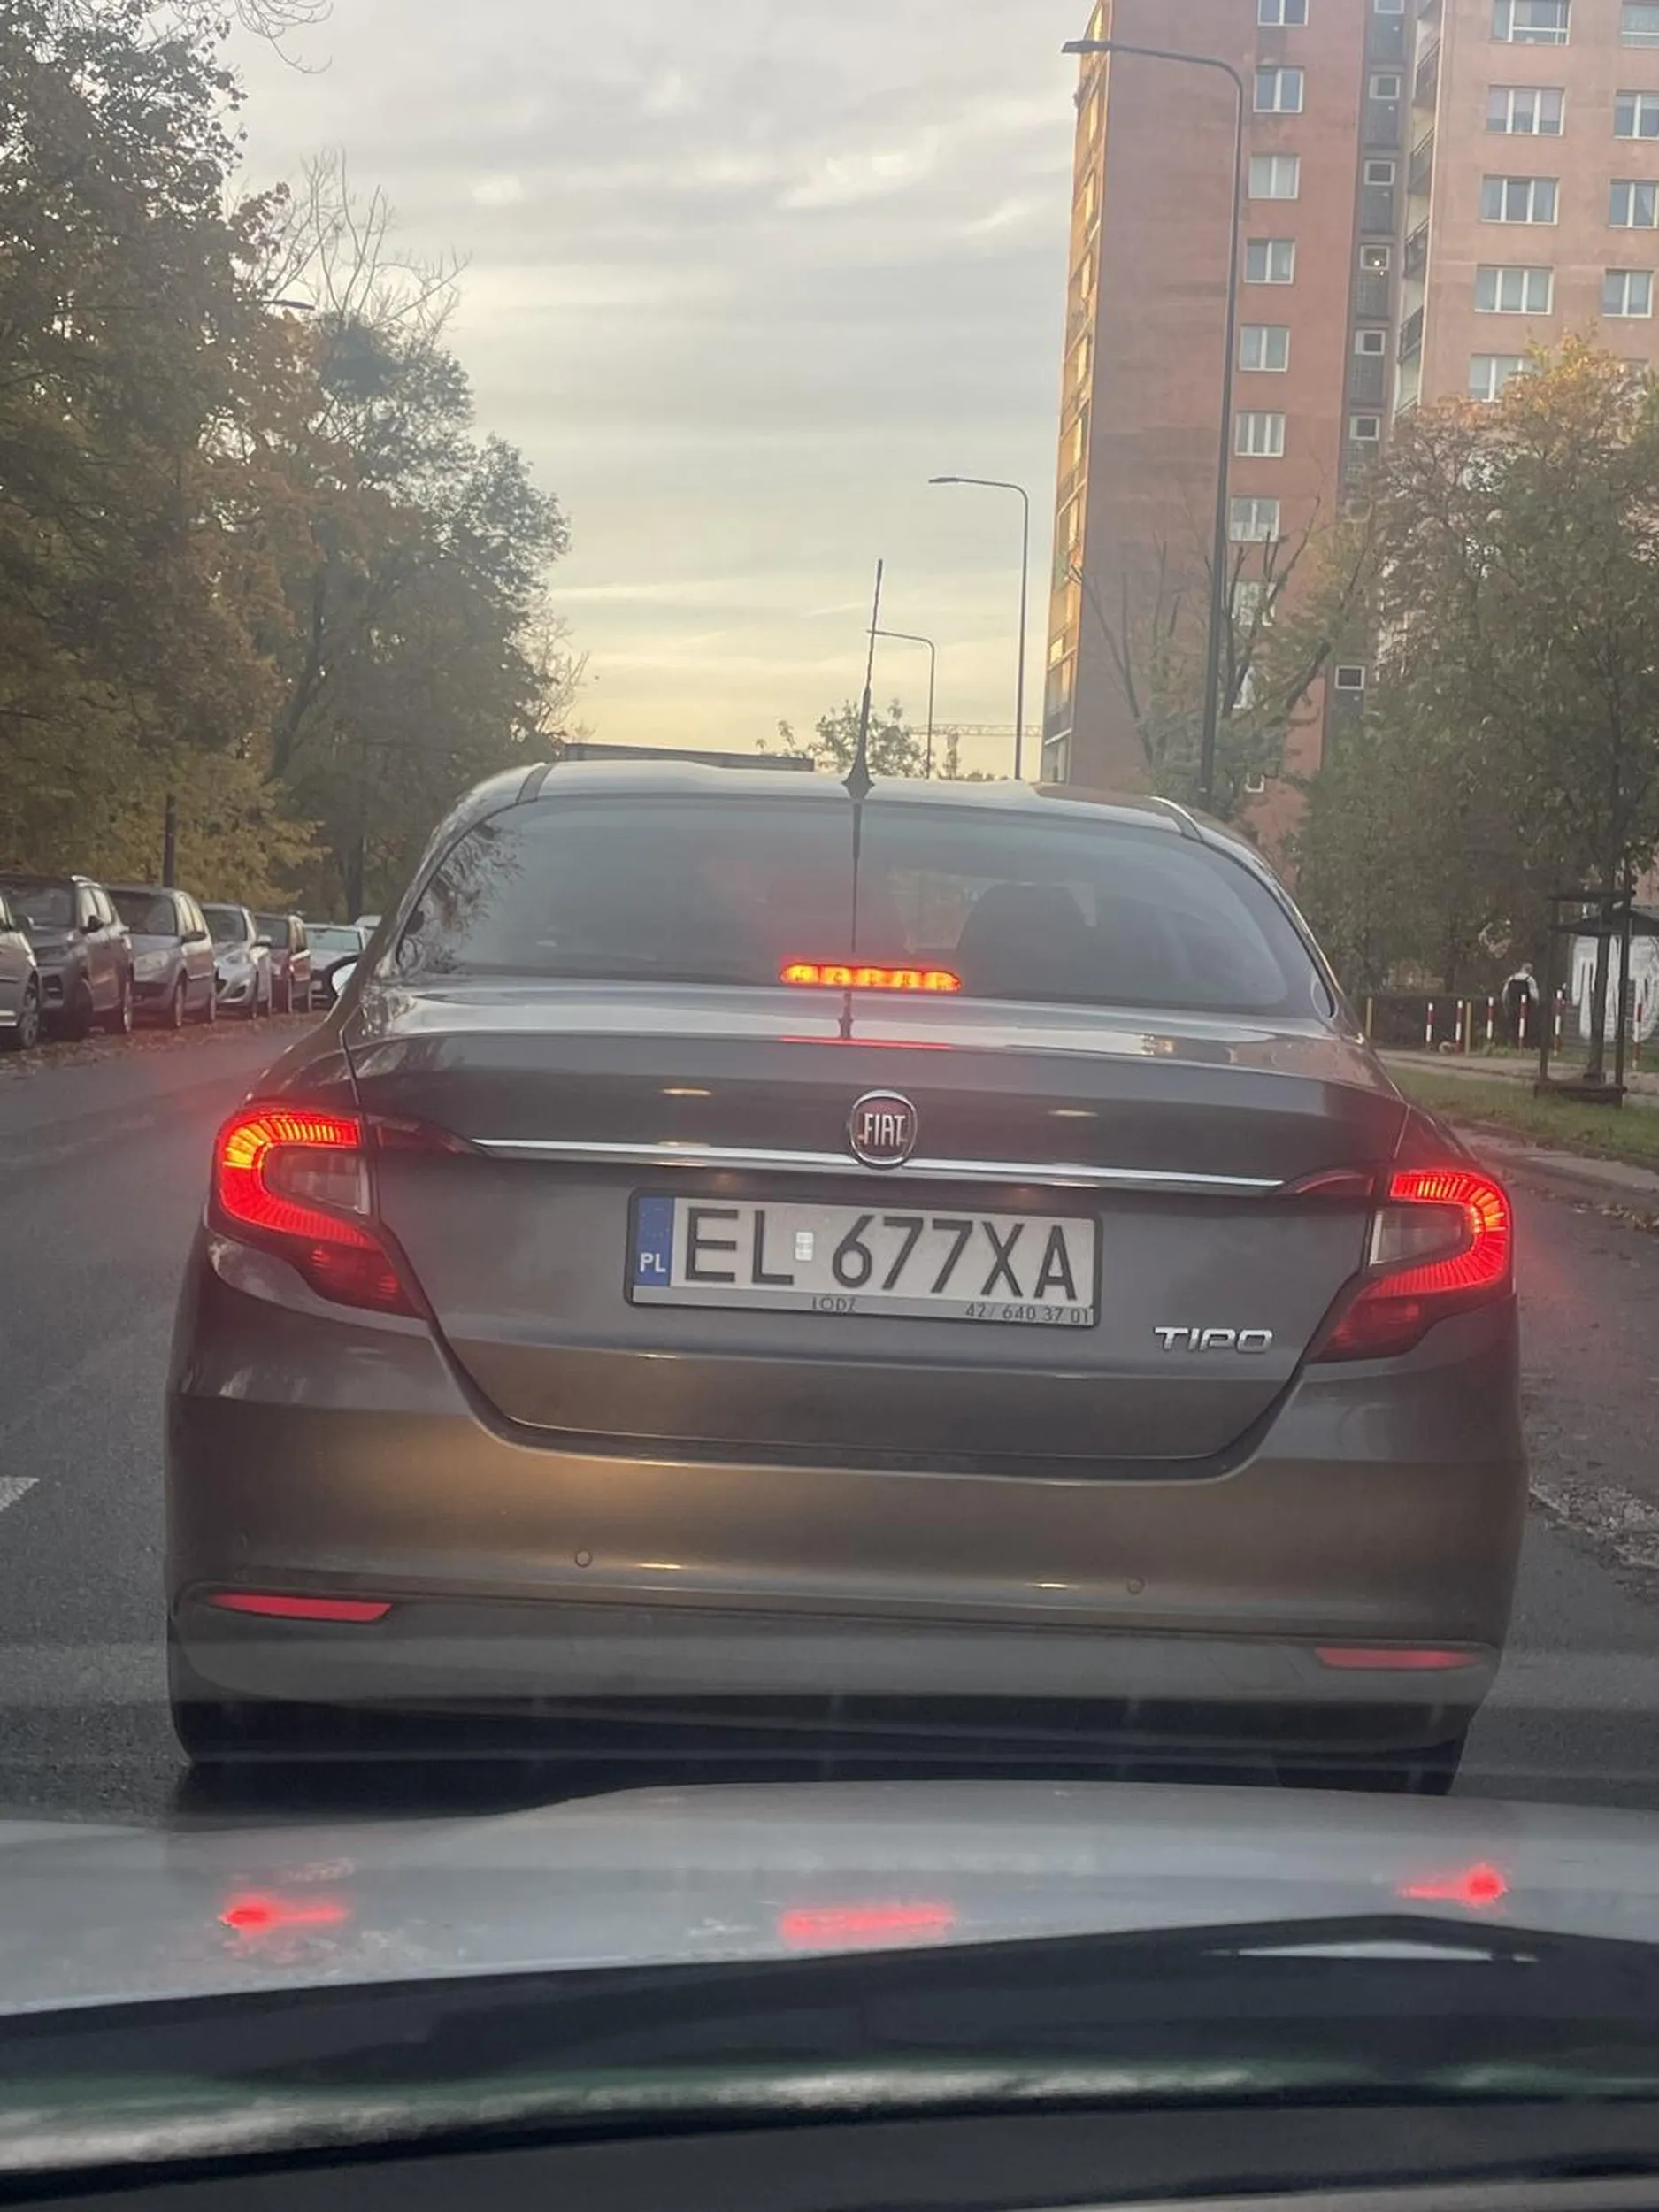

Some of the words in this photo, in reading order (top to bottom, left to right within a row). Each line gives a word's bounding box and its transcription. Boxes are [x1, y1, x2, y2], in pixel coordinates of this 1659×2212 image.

[864, 1112, 906, 1147] FIAT
[640, 1252, 666, 1272] PL
[685, 1206, 794, 1285] EL
[832, 1215, 1077, 1300] 677XA
[1002, 1303, 1036, 1321] 640
[1044, 1305, 1064, 1322] 37
[1070, 1308, 1089, 1324] 01
[1154, 1326, 1273, 1354] TIPO
